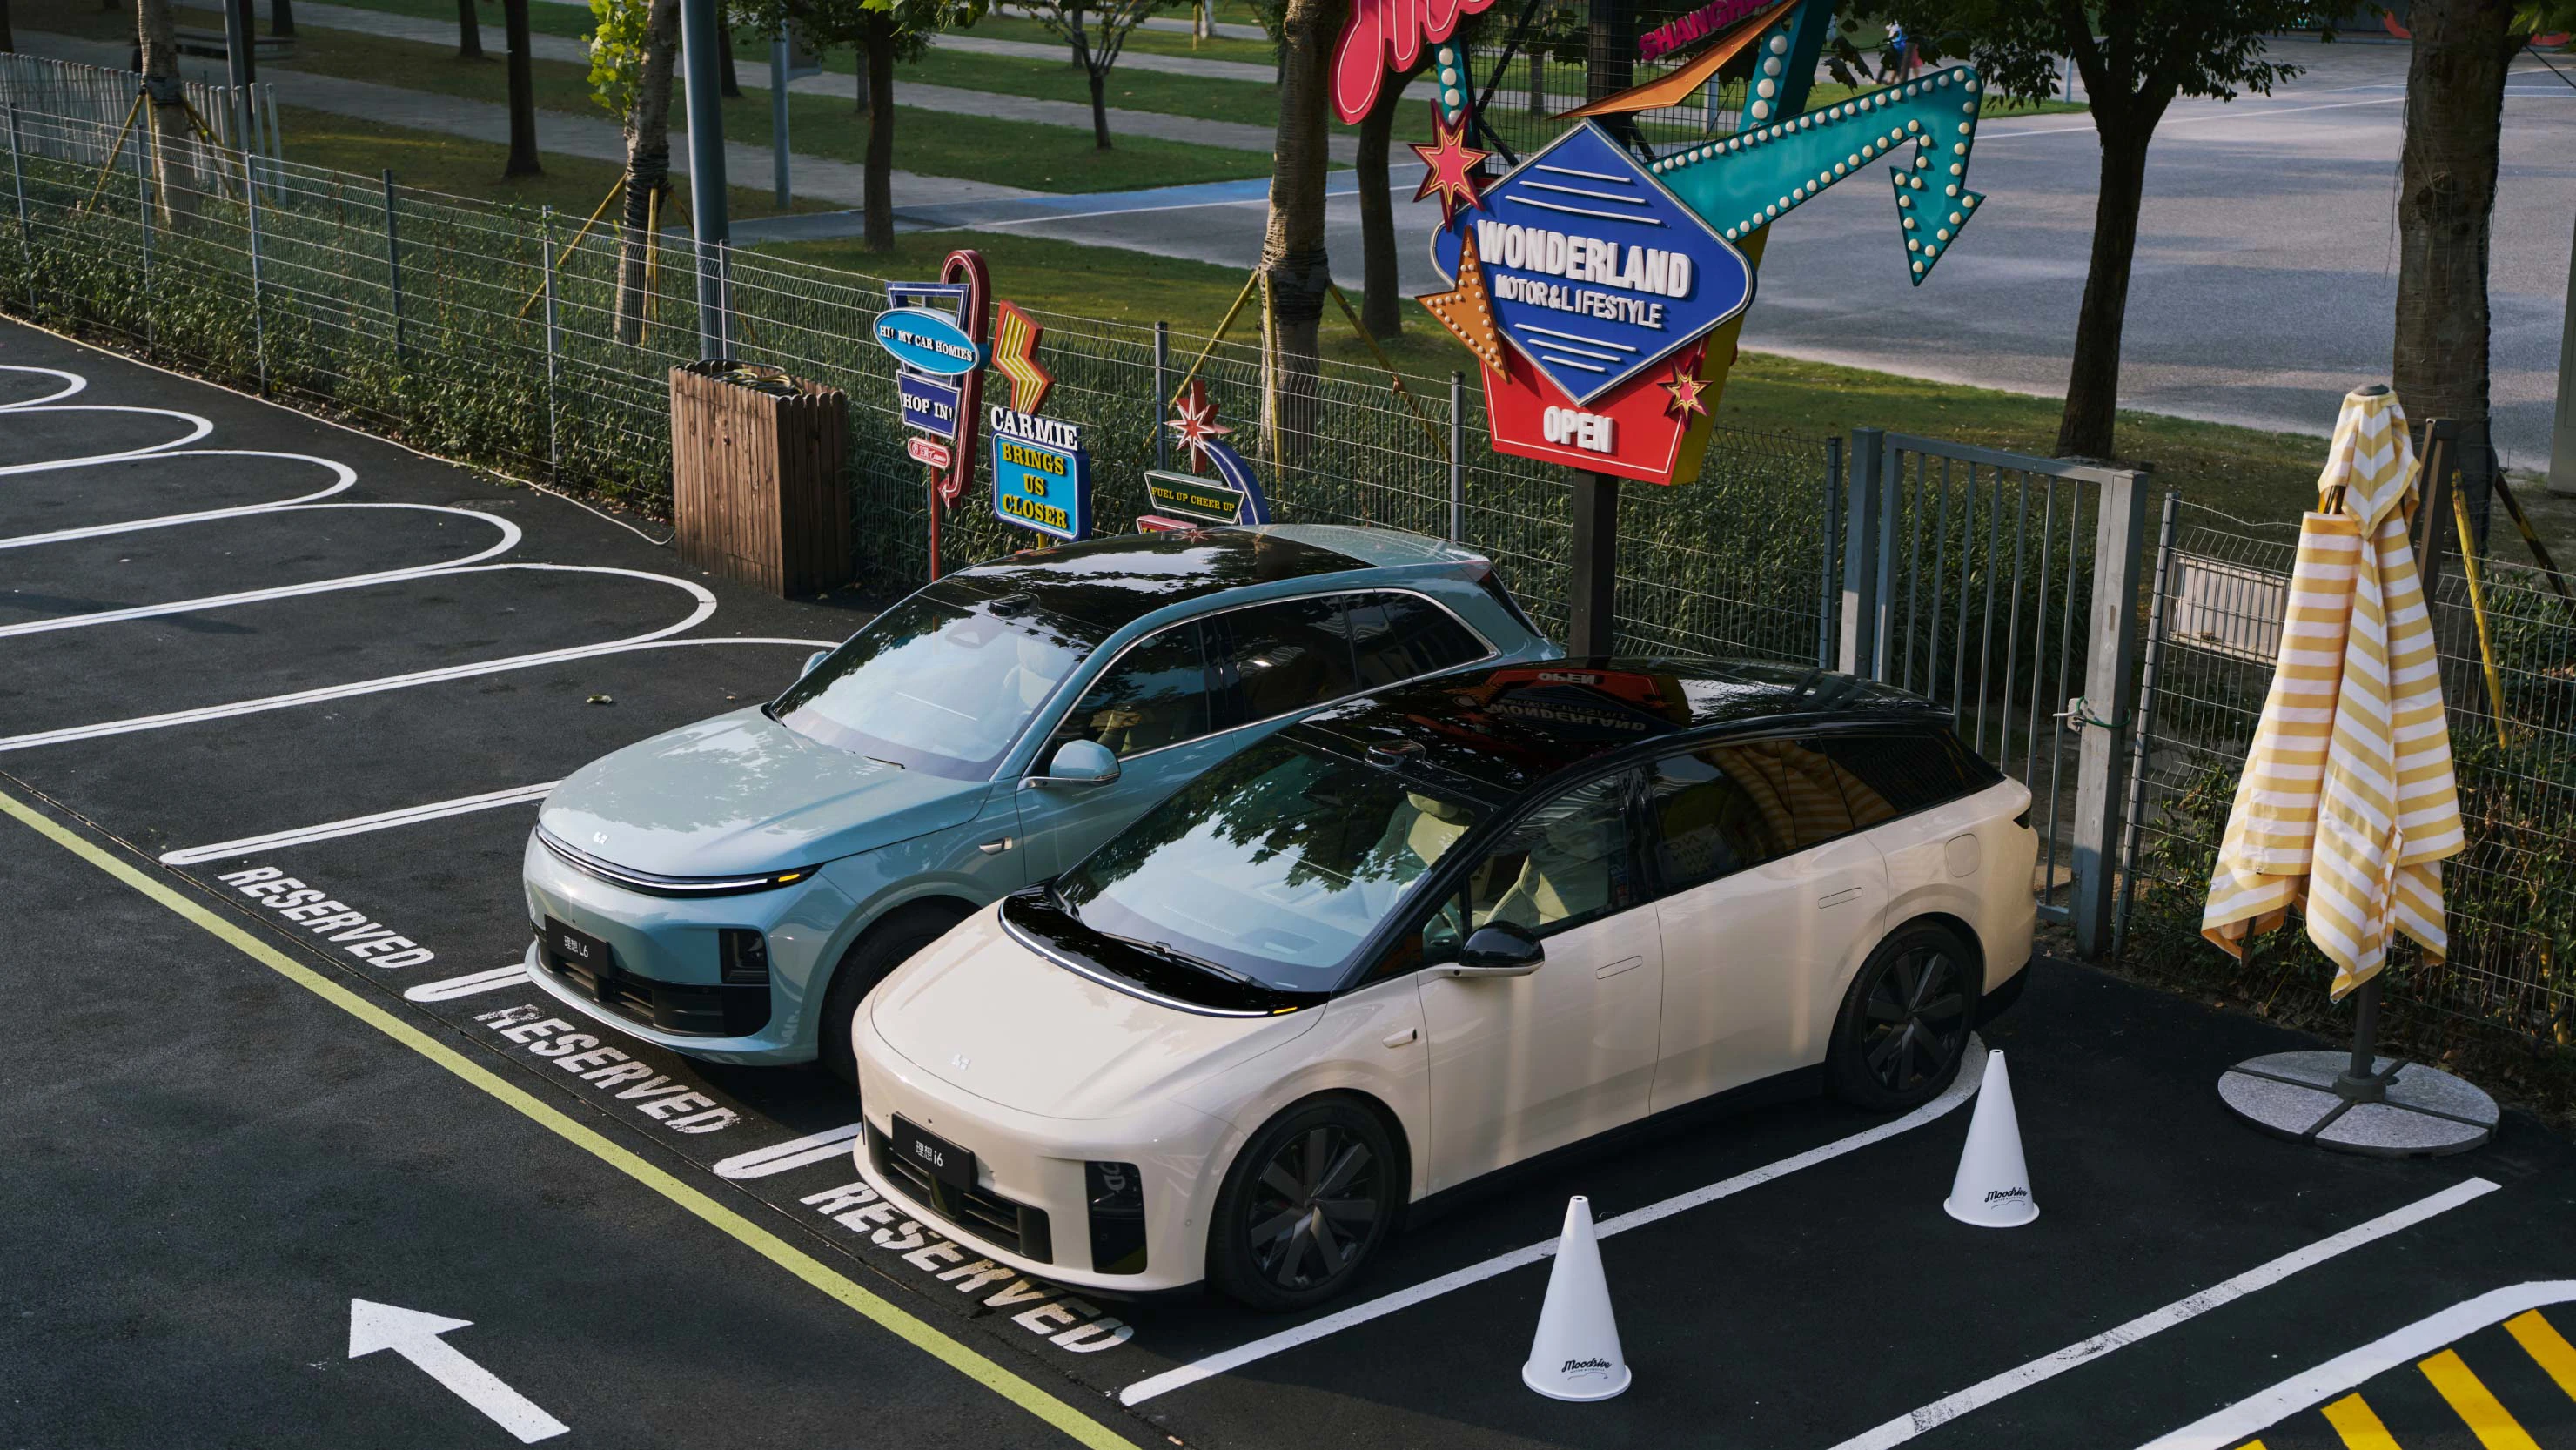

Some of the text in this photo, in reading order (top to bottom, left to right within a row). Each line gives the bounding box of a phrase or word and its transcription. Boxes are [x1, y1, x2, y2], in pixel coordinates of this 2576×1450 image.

[1477, 219, 1692, 299] WONDERLAND
[879, 325, 973, 362] HI! MY CAR HOMIES
[902, 393, 953, 422] HOP IN!
[990, 406, 1078, 451] CARMIE
[1543, 405, 1613, 453] OPEN
[1002, 442, 1064, 475] BRINGS
[1023, 473, 1045, 496] US
[1151, 487, 1235, 513] FUEL UP CHEER UP
[1002, 493, 1068, 529] CLOSER
[218, 866, 435, 969] RESERVED
[473, 1004, 741, 1134] RESERVED
[799, 1181, 1135, 1353] RESERVED
